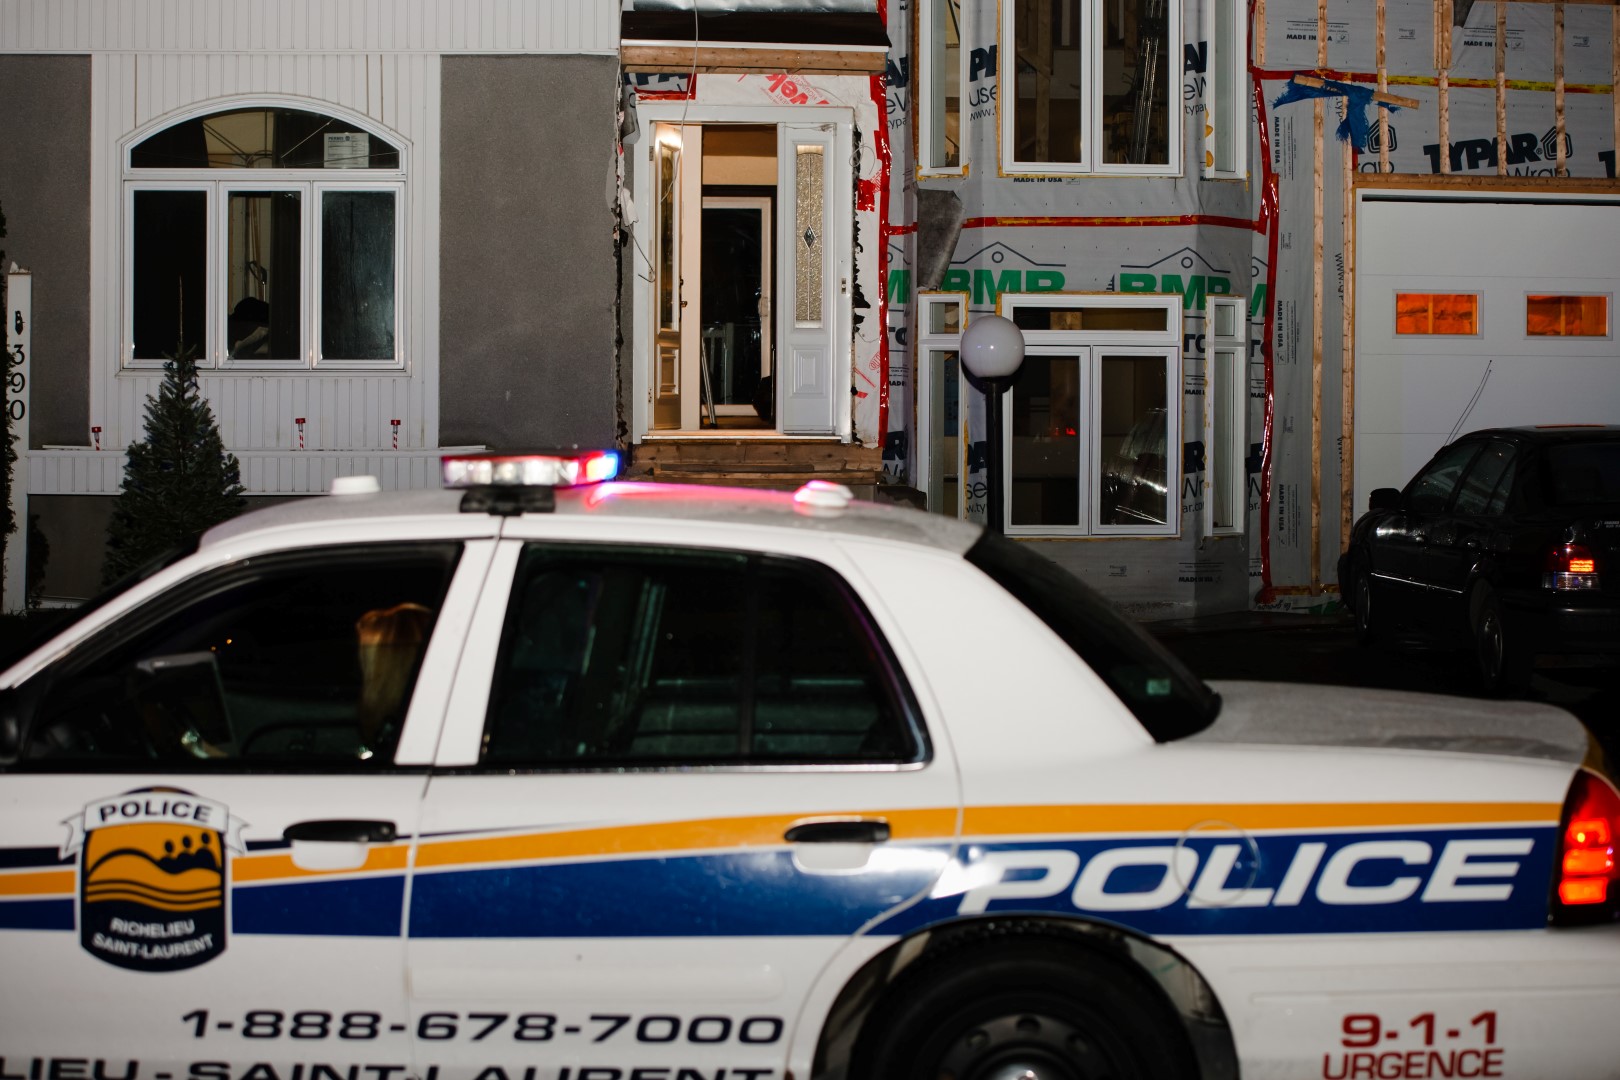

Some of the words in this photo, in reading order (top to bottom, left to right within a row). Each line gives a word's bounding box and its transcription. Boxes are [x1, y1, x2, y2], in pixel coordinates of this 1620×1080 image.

[10, 344, 26, 421] 390
[99, 799, 213, 823] POLICE
[956, 838, 1535, 916] POLICE
[110, 917, 196, 938] RICHELIEU
[92, 932, 214, 959] SAINT-LAURENT
[182, 1009, 785, 1045] 1-888-678-7000
[1341, 1011, 1498, 1047] 9-1-1
[1322, 1049, 1504, 1080] URGENCE
